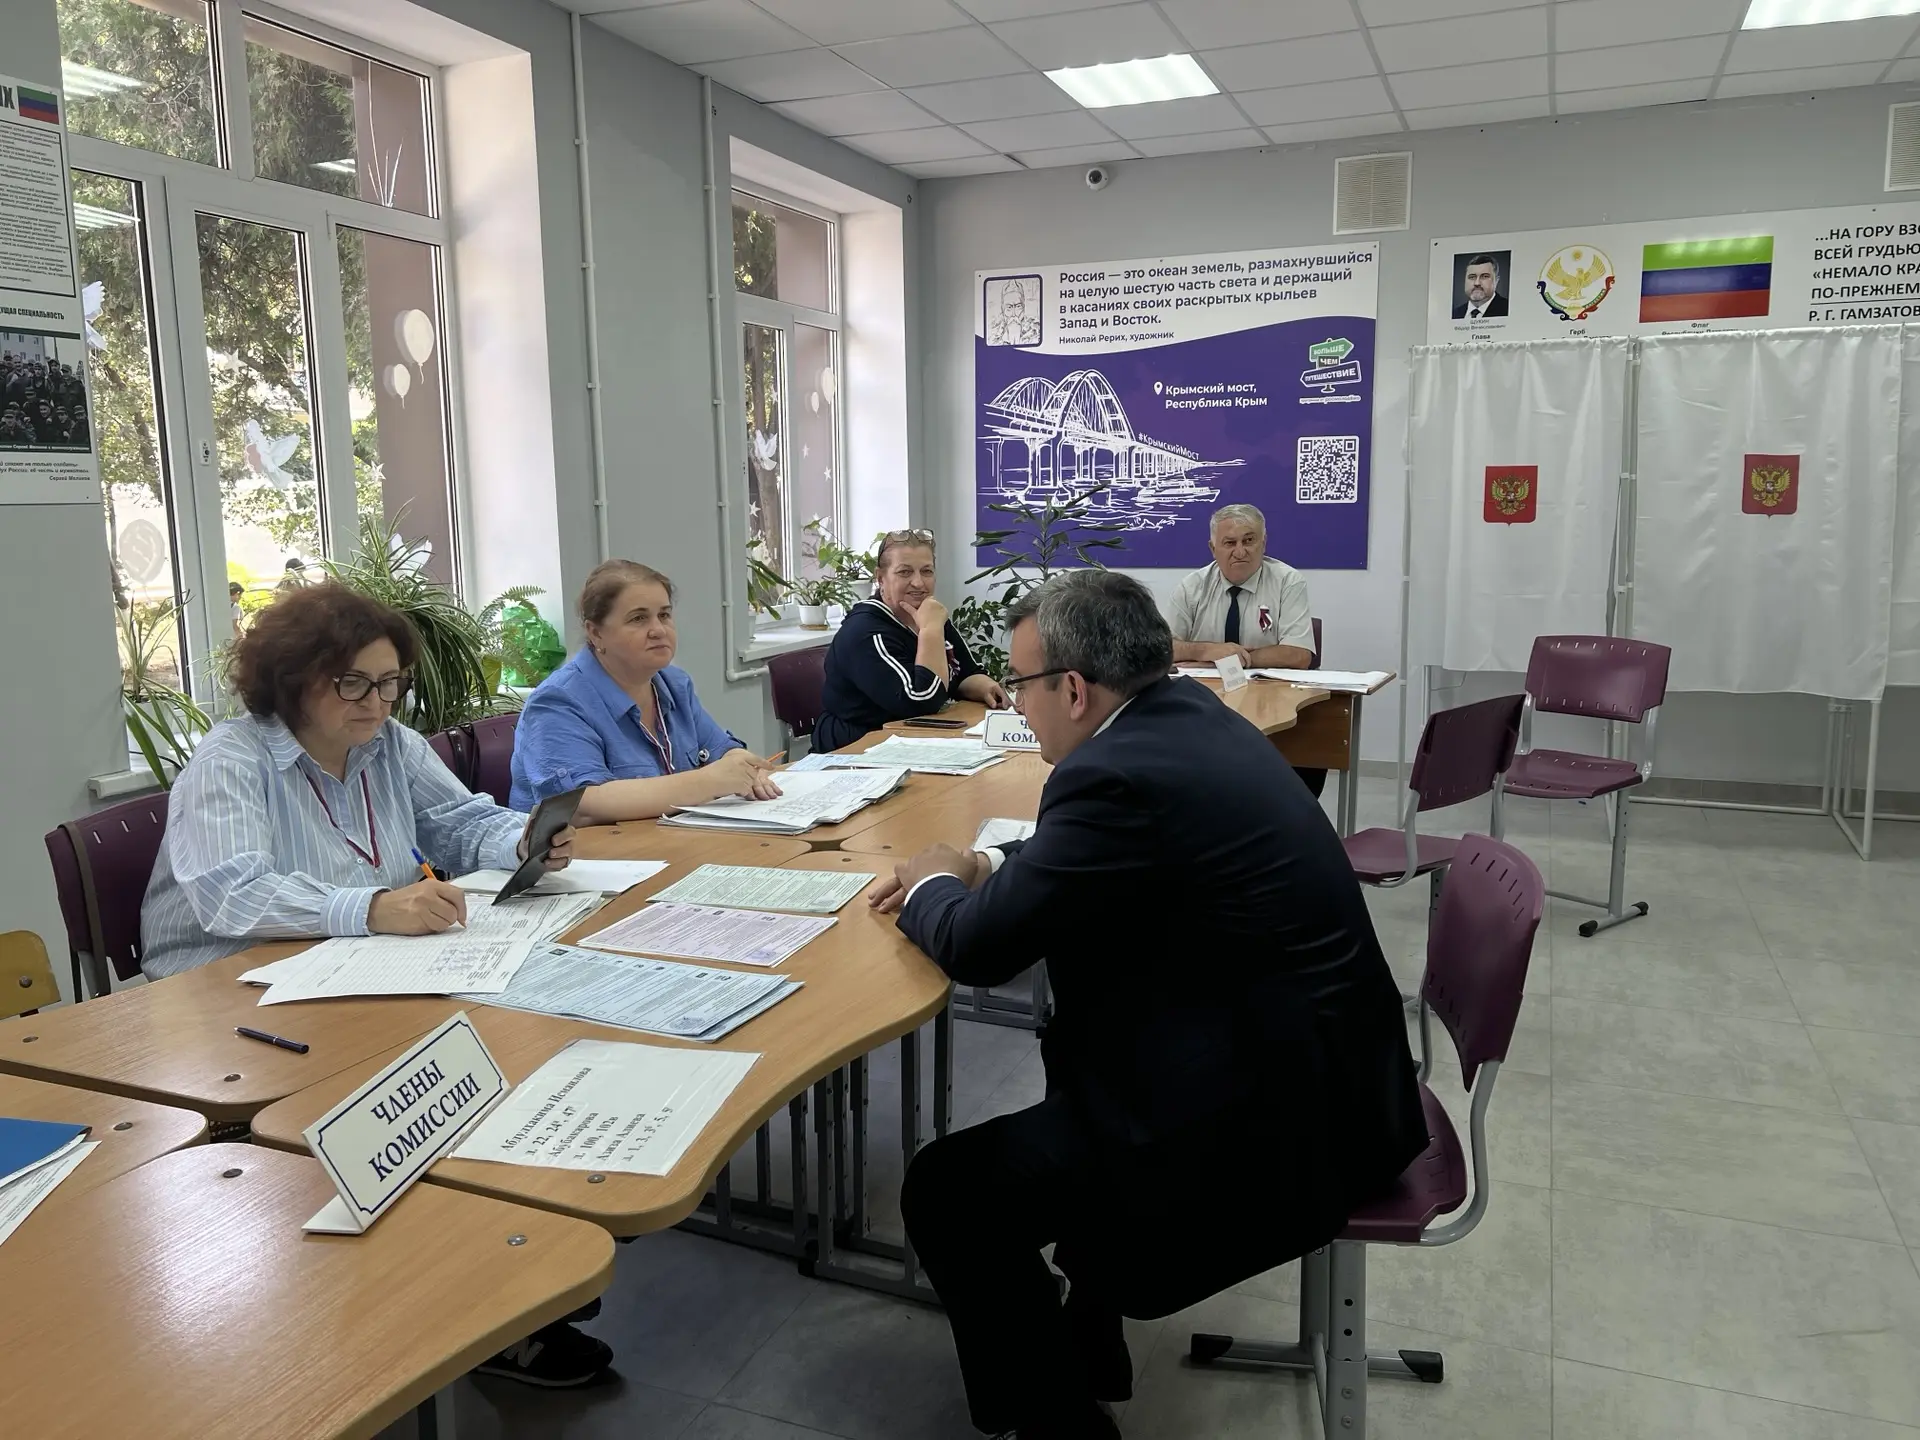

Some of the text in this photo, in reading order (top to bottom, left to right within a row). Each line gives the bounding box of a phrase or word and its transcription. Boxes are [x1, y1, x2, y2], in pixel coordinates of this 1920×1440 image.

[1815, 223, 1920, 241] ...НА ГОРУ ВЗ
[1814, 243, 1920, 260] ВСЕЙ ГРУДЬЮ
[1060, 272, 1105, 283] Россия
[1124, 269, 1145, 279] это
[1148, 265, 1188, 278] океан
[1191, 263, 1245, 275] земель,
[1248, 251, 1373, 273] размахнувшийся
[1813, 264, 1892, 279] «НЕМАЛО
[1059, 268, 1352, 299] на целую шестую часть света и держащий
[1059, 289, 1317, 314] в касаниях своих раскрытых крыльев
[18, 308, 65, 320] СПЕЦИАЛЬНОСТЬ
[1809, 305, 1920, 321] Р. Г. ГАМЗАТОВ
[1059, 314, 1162, 329] Запад и Восток.
[1059, 331, 1175, 344] Николай Рерих, художник
[1165, 382, 1257, 397] Крымский мост,
[1165, 397, 1268, 410] Республика Крым
[370, 1059, 445, 1125] ЧЛЕНЫ
[368, 1072, 481, 1182] КОМИССИИ
[532, 1135, 554, 1145] 22,
